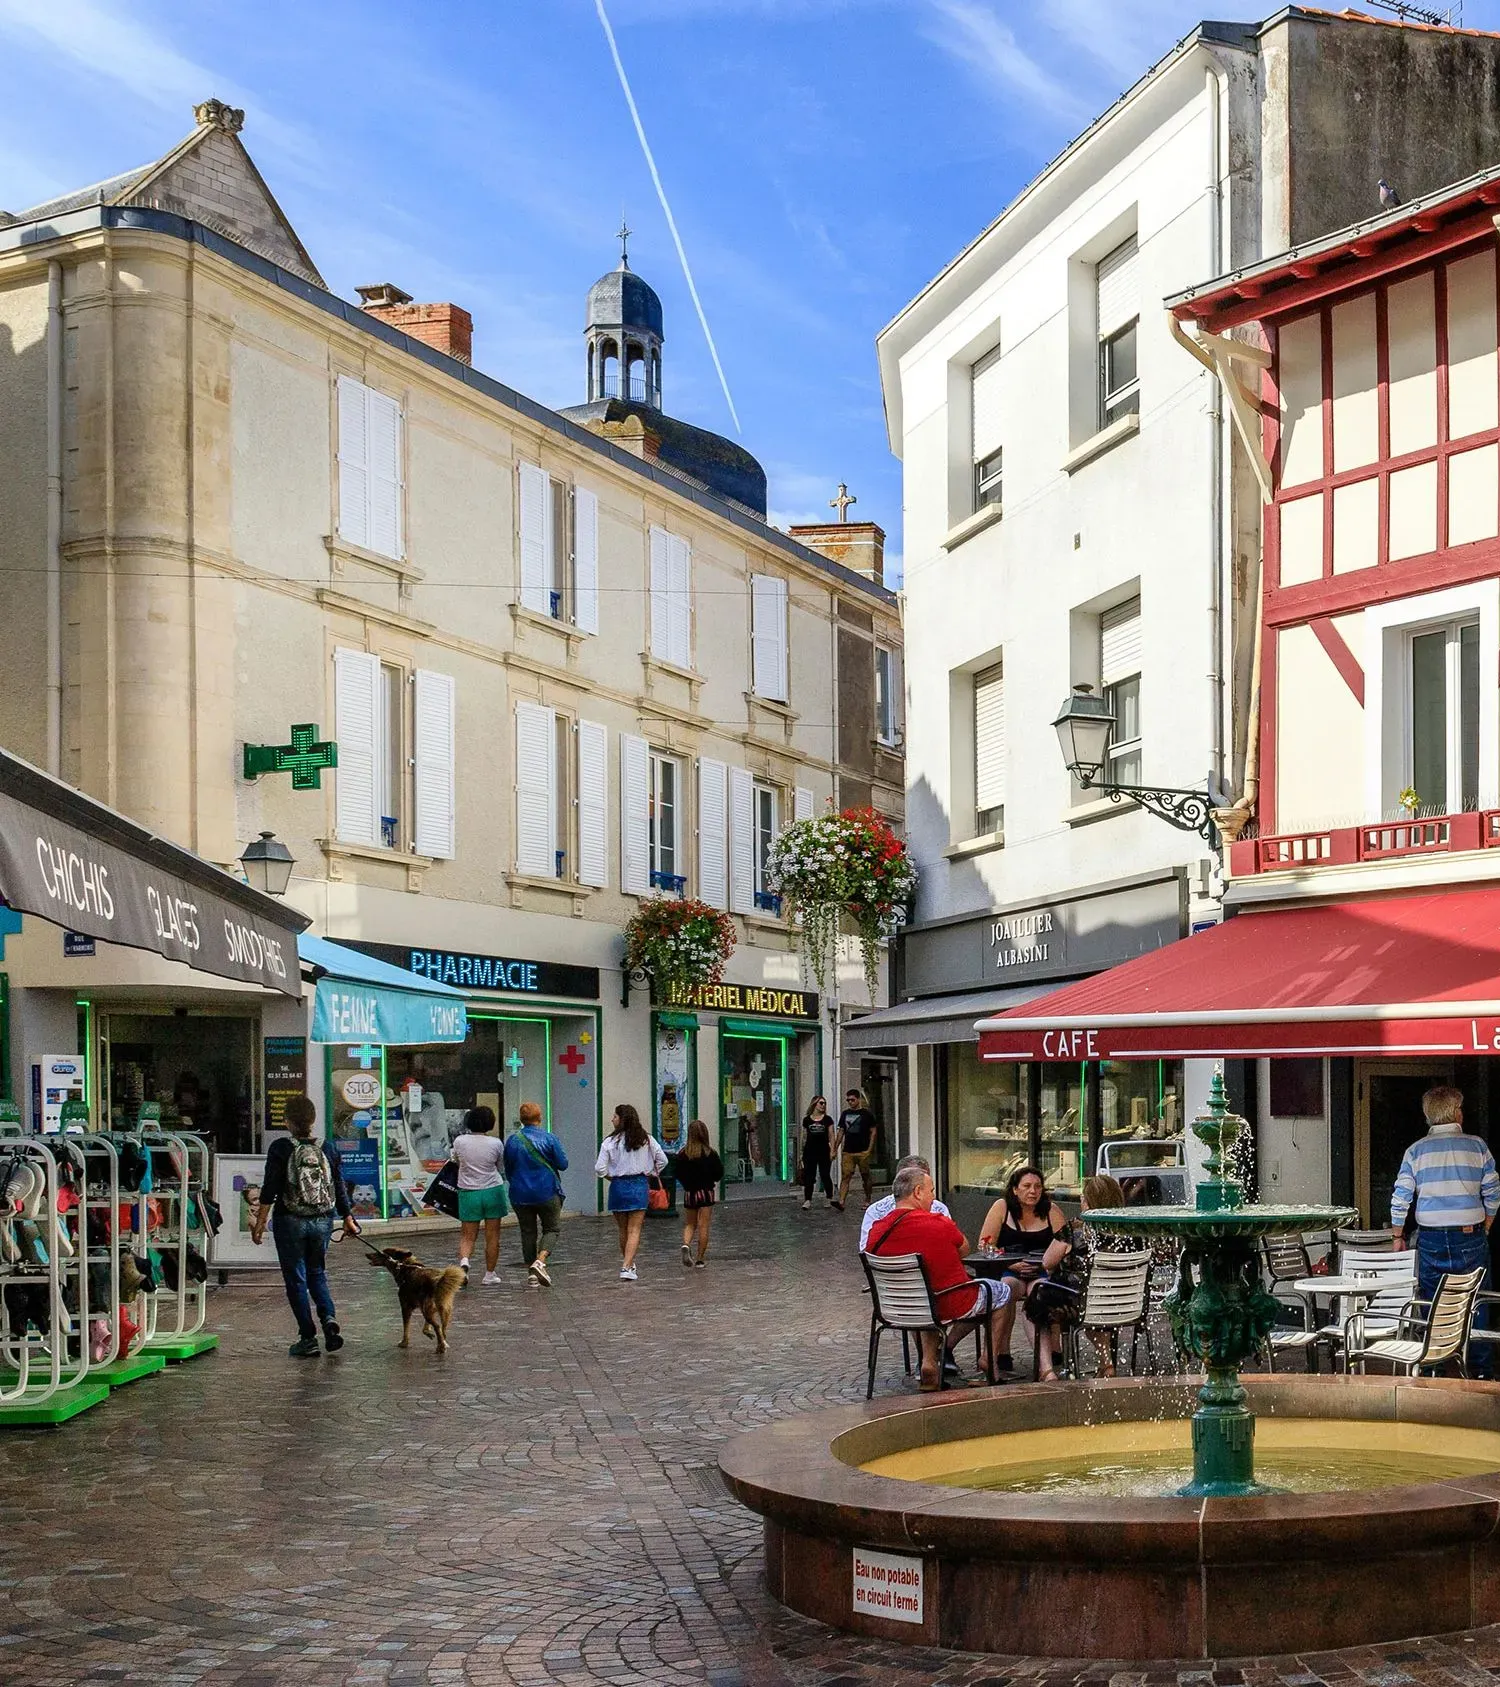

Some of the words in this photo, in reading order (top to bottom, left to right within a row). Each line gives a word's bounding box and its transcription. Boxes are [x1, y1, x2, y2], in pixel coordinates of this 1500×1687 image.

[36, 836, 115, 920] CHICHIS
[147, 886, 200, 951] GLACES
[990, 912, 1053, 947] JOAILLIER
[996, 943, 1049, 968] ALBASINI
[410, 950, 539, 991] PHARMACIE
[746, 986, 808, 1016] MÉDICAL
[1042, 1029, 1100, 1057] CAFE
[346, 1080, 379, 1095] STOP
[855, 1558, 870, 1578] Eau
[871, 1566, 886, 1581] non
[887, 1567, 920, 1587] potable
[856, 1587, 866, 1602] en
[867, 1587, 892, 1608] circuit
[893, 1591, 919, 1612] fermé
